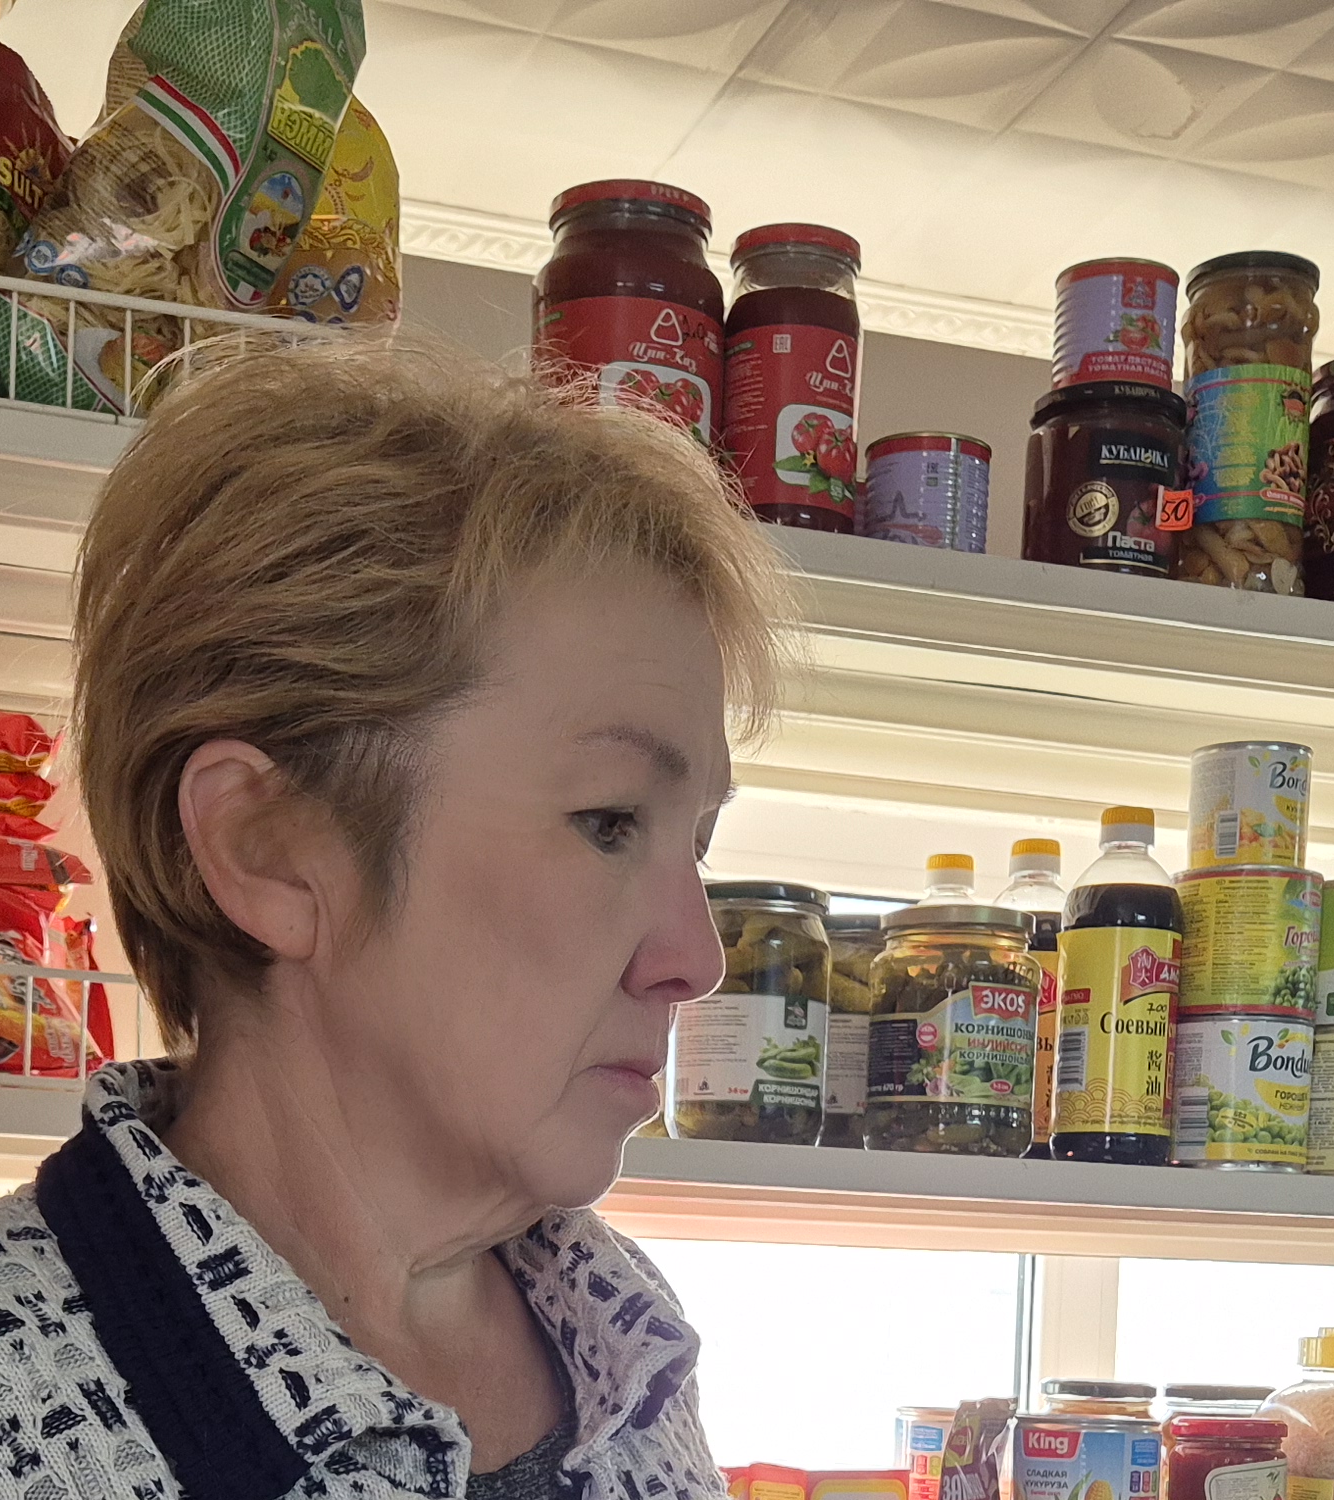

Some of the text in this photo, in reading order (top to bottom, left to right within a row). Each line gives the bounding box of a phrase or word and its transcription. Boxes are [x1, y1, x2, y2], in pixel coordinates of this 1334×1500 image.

[1107, 530, 1156, 553] Паста
[1100, 1012, 1168, 1038] Соевый
[1028, 1431, 1069, 1454] King
[1024, 1480, 1069, 1490] КУКУРУЗА
[1026, 1468, 1068, 1479] СЛАДКАЯ
